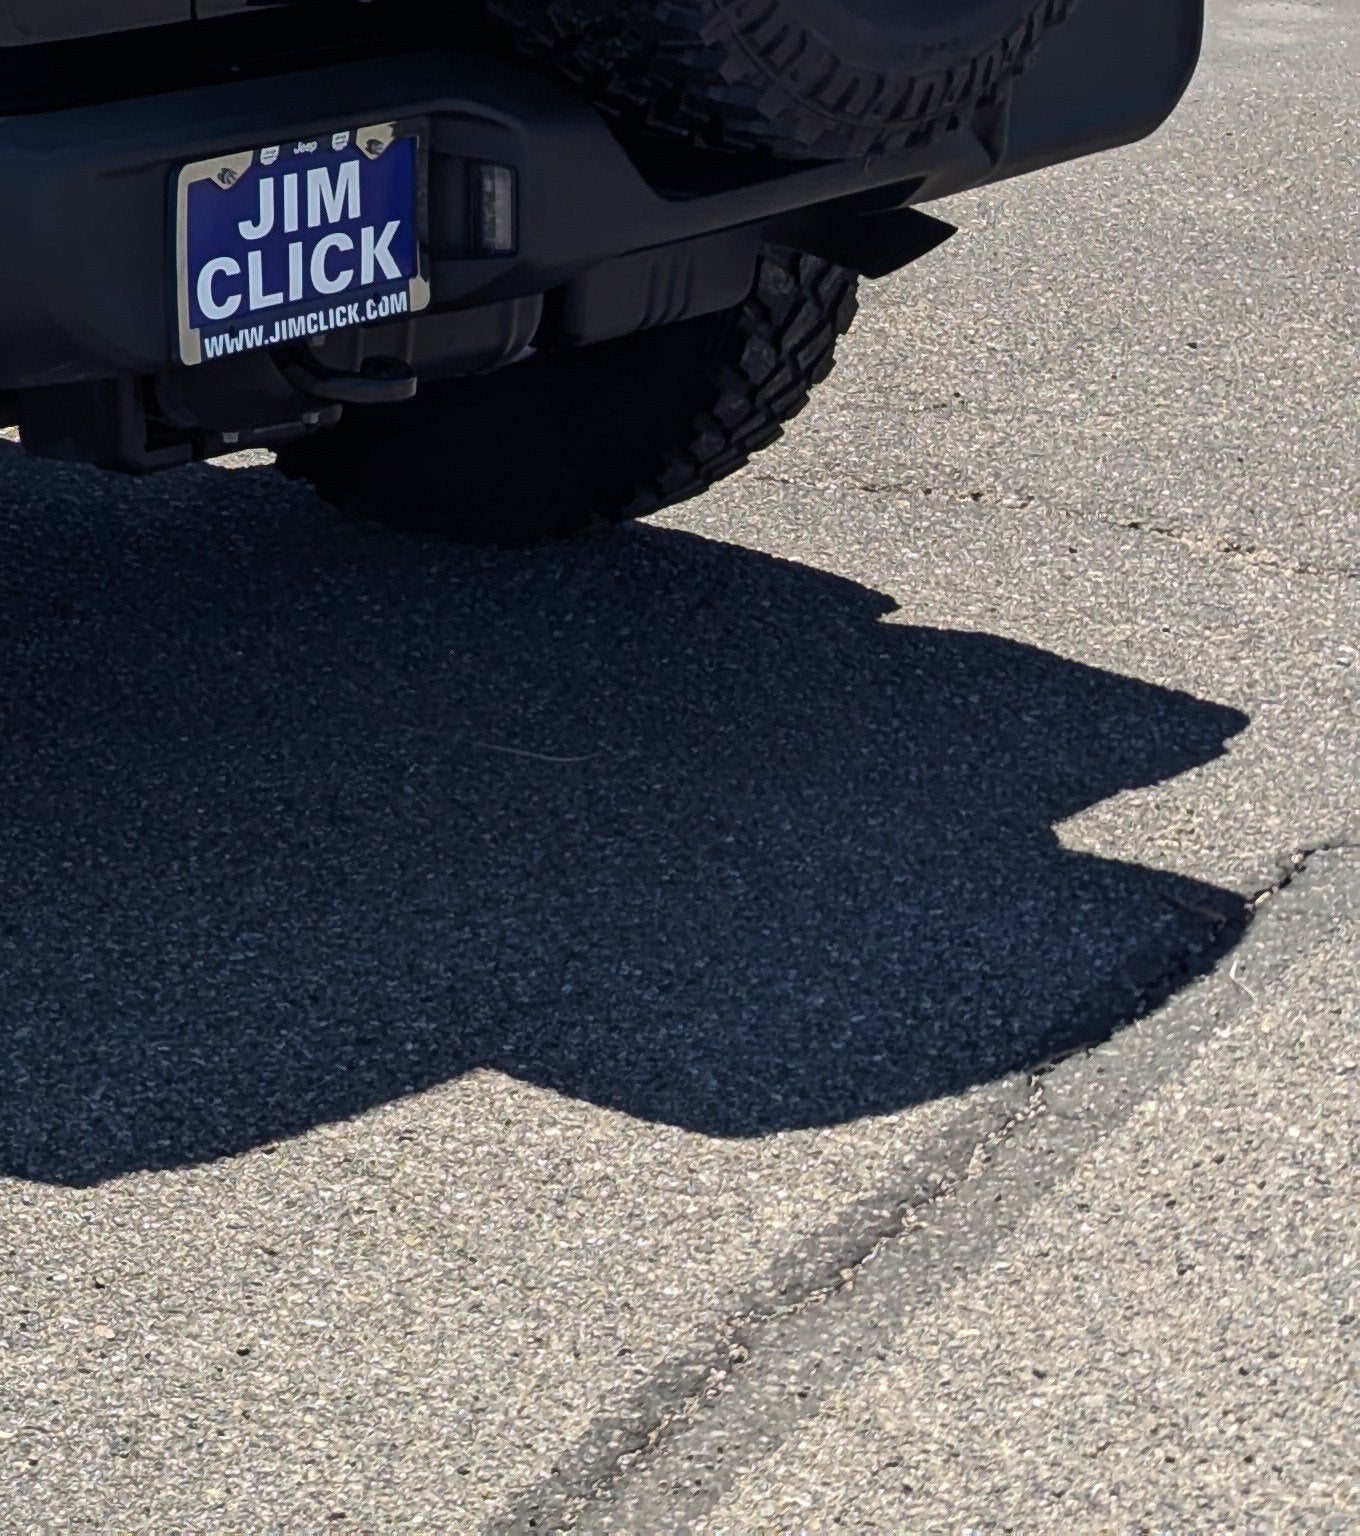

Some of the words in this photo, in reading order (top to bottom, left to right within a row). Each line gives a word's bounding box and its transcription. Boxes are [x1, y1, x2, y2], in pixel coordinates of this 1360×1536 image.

[237, 159, 362, 241] JIM
[196, 219, 403, 321] CLICK
[204, 290, 408, 359] WWW.JIMCLICK.COM
